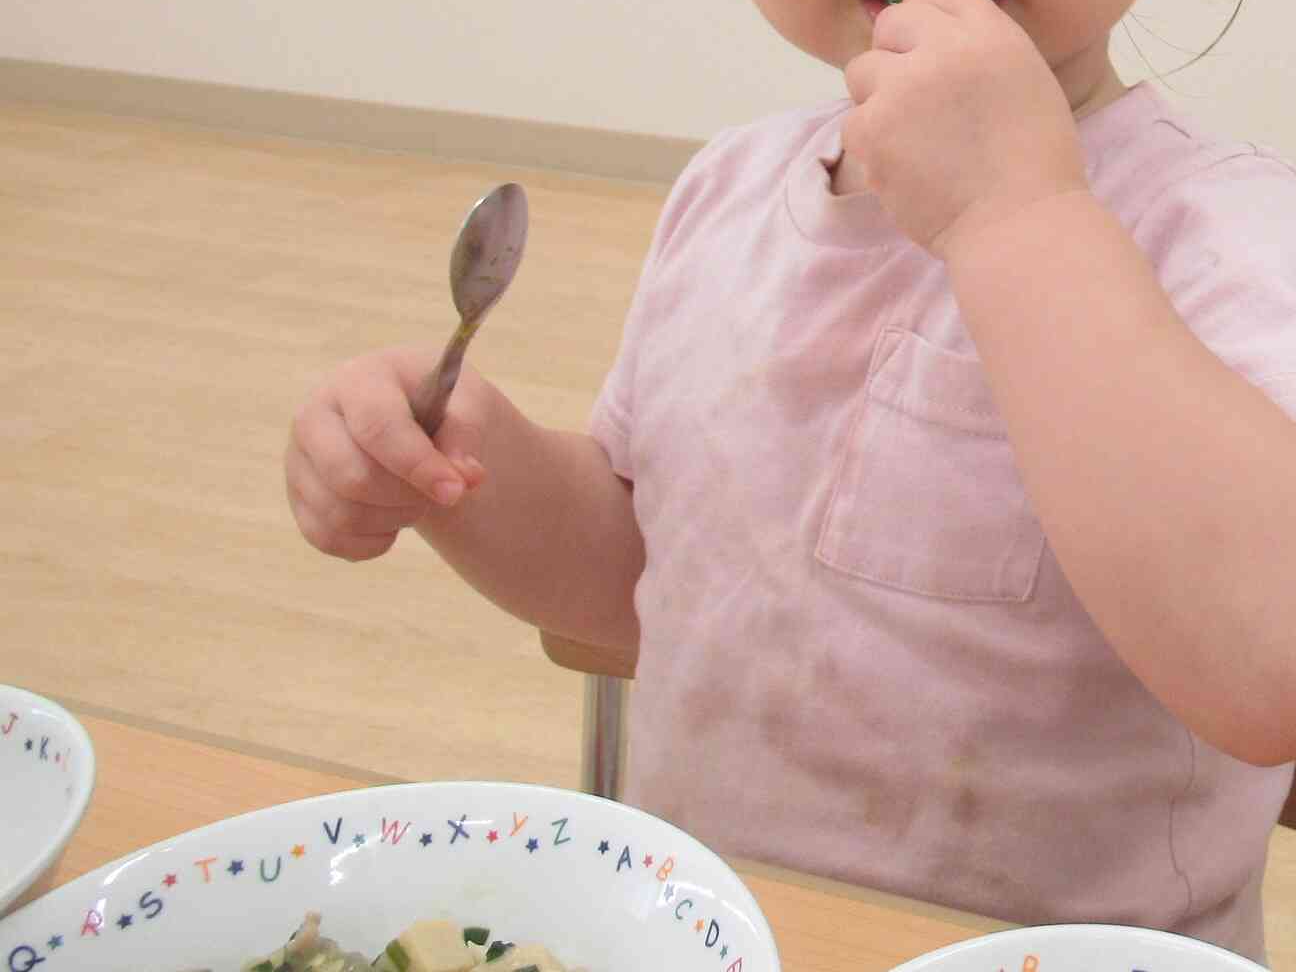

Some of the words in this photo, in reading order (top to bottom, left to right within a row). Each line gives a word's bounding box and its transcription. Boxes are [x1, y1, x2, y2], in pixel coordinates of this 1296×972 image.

[8, 945, 46, 972] Q
[81, 909, 102, 936] R
[139, 891, 163, 919] S
[194, 857, 217, 883] T
[260, 856, 281, 882] U
[323, 817, 342, 844] V
[380, 817, 411, 845] W
[447, 814, 470, 844] X
[510, 811, 528, 837] Y
[551, 817, 571, 845] Z
[616, 845, 632, 872] A
[656, 857, 675, 881] B
[675, 899, 693, 920] C
[705, 919, 720, 948] D
